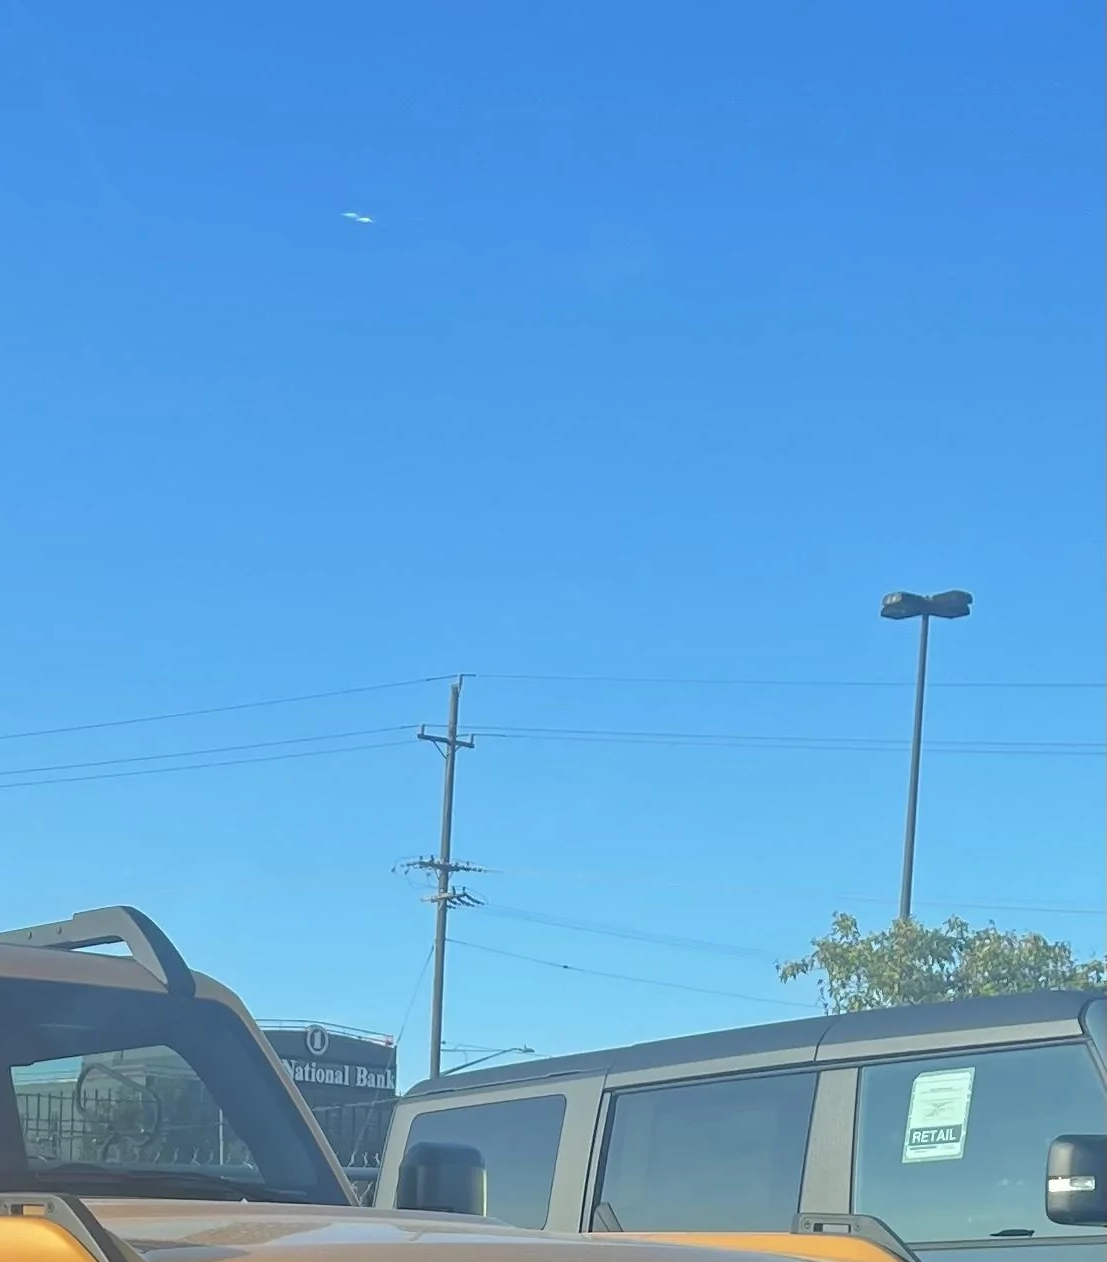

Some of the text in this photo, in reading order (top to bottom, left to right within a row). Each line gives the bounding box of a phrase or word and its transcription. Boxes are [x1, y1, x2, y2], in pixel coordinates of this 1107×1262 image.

[281, 1058, 396, 1090] National Bank
[911, 1128, 957, 1144] RETAIL
